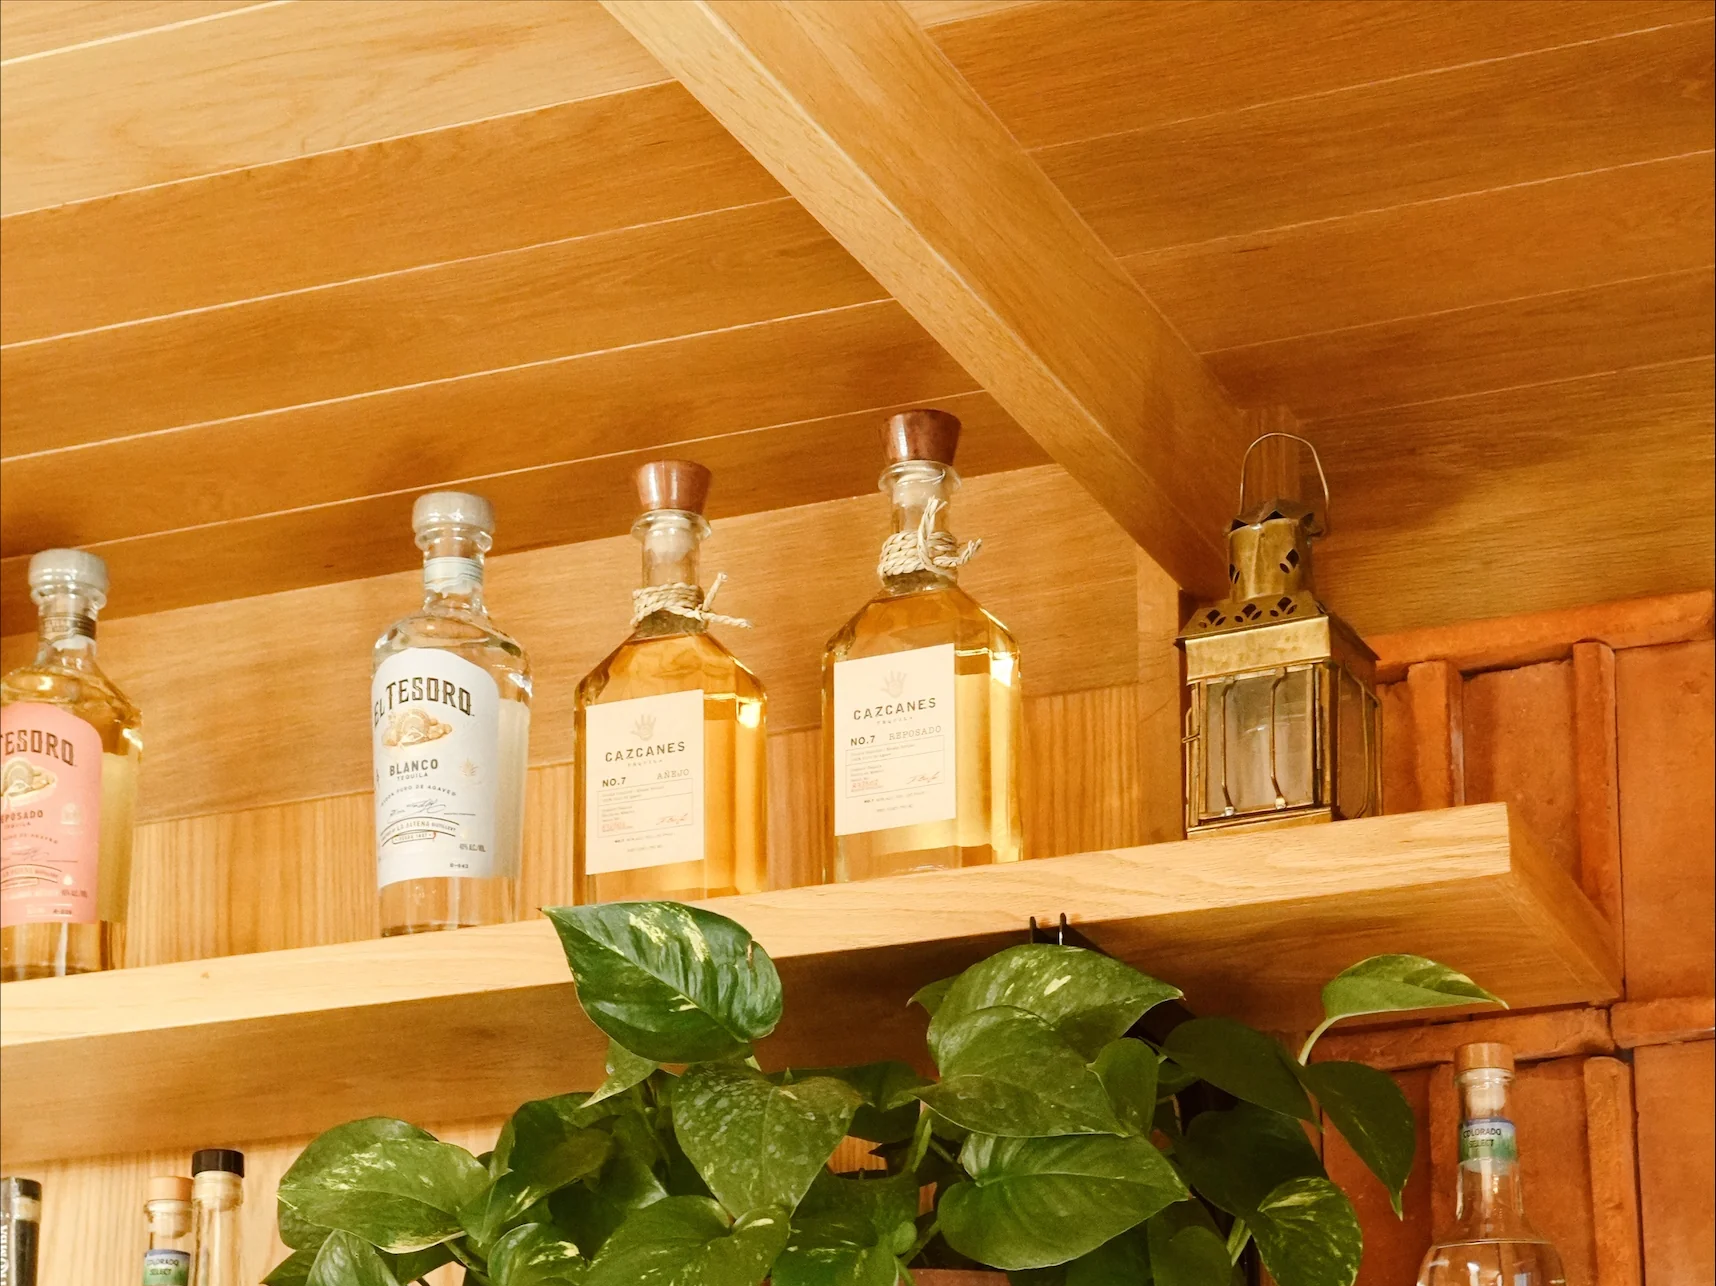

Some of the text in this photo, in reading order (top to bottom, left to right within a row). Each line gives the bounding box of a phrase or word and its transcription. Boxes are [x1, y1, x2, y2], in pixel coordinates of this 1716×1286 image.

[374, 677, 470, 727] EL TESORO
[854, 698, 936, 720] CAZCANES
[851, 726, 942, 746] NO.7 REPOSADO
[0, 729, 74, 766] ESORO
[605, 742, 686, 762] CAZCANES
[390, 759, 438, 776] BLANCO
[397, 773, 428, 781] TEQUILA
[602, 769, 689, 787] NO.7 AÑEJO
[0, 810, 43, 823] EPOSADO
[1463, 1128, 1501, 1138] COLORADO
